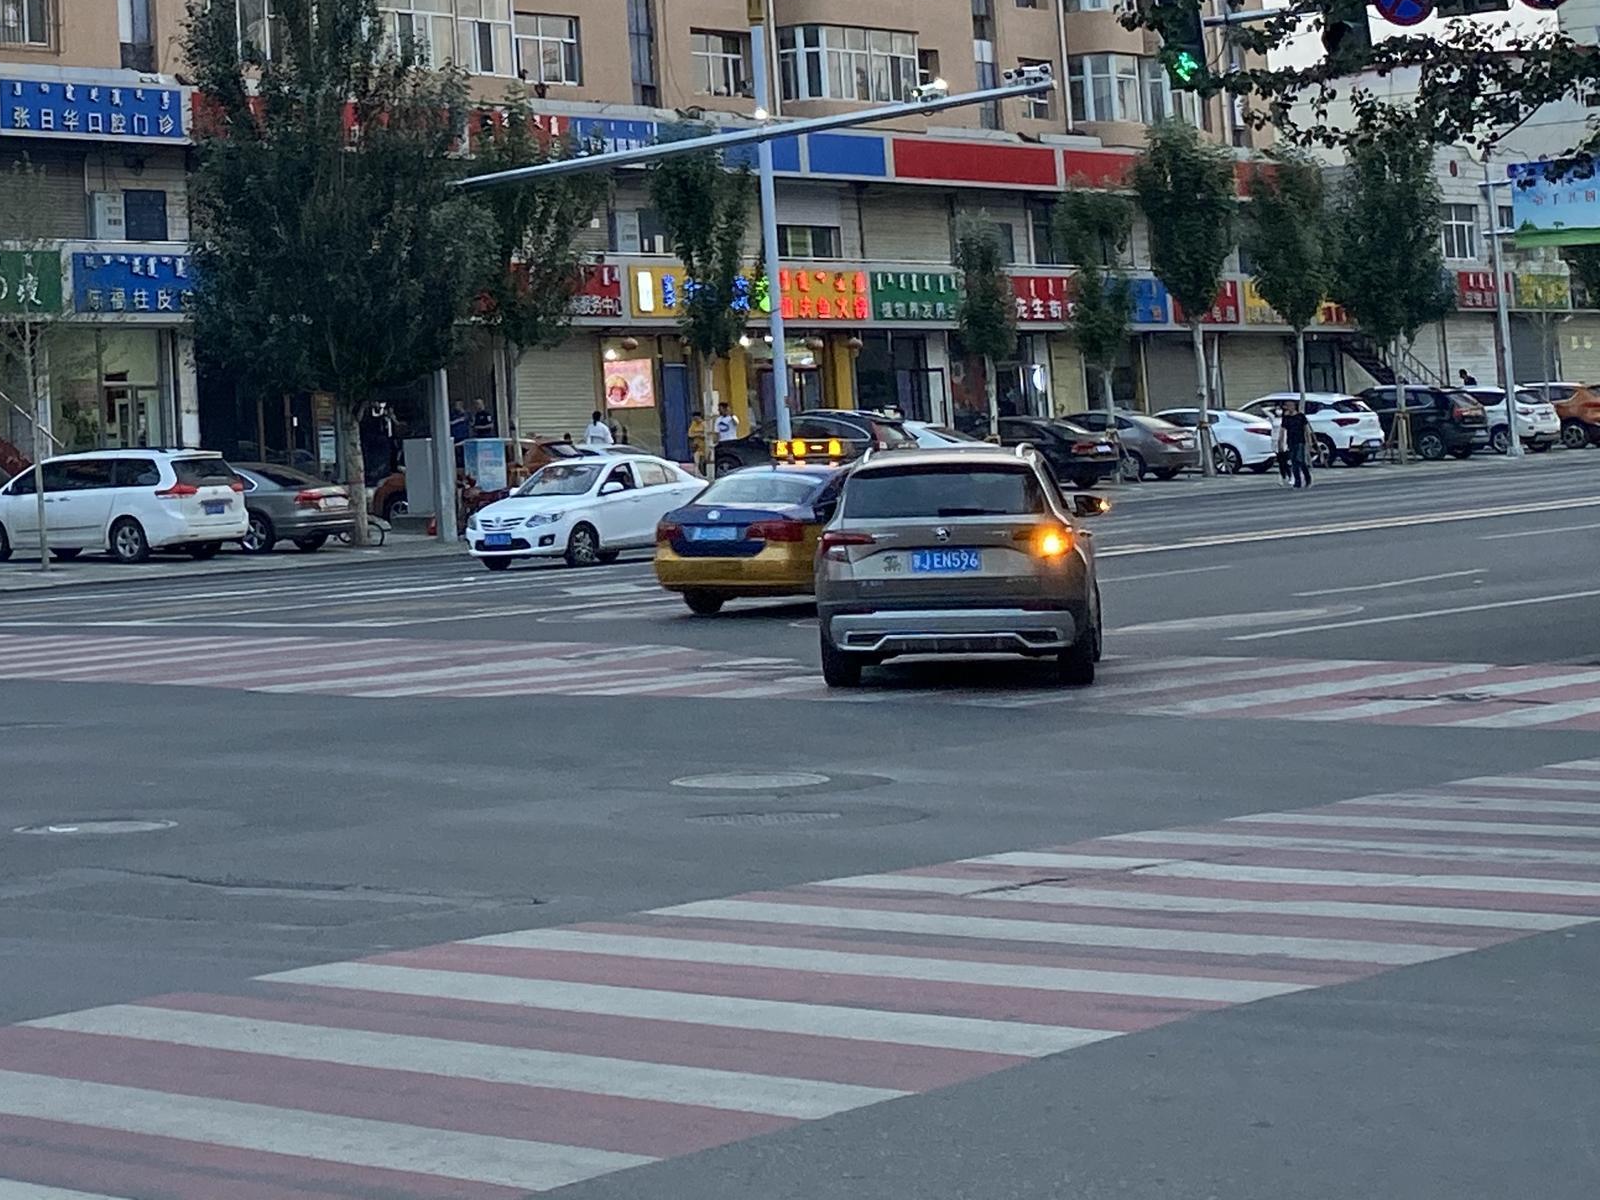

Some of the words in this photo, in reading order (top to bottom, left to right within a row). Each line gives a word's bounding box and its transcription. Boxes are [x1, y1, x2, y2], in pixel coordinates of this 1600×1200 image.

[13, 106, 175, 135] 张日华口腔门诊
